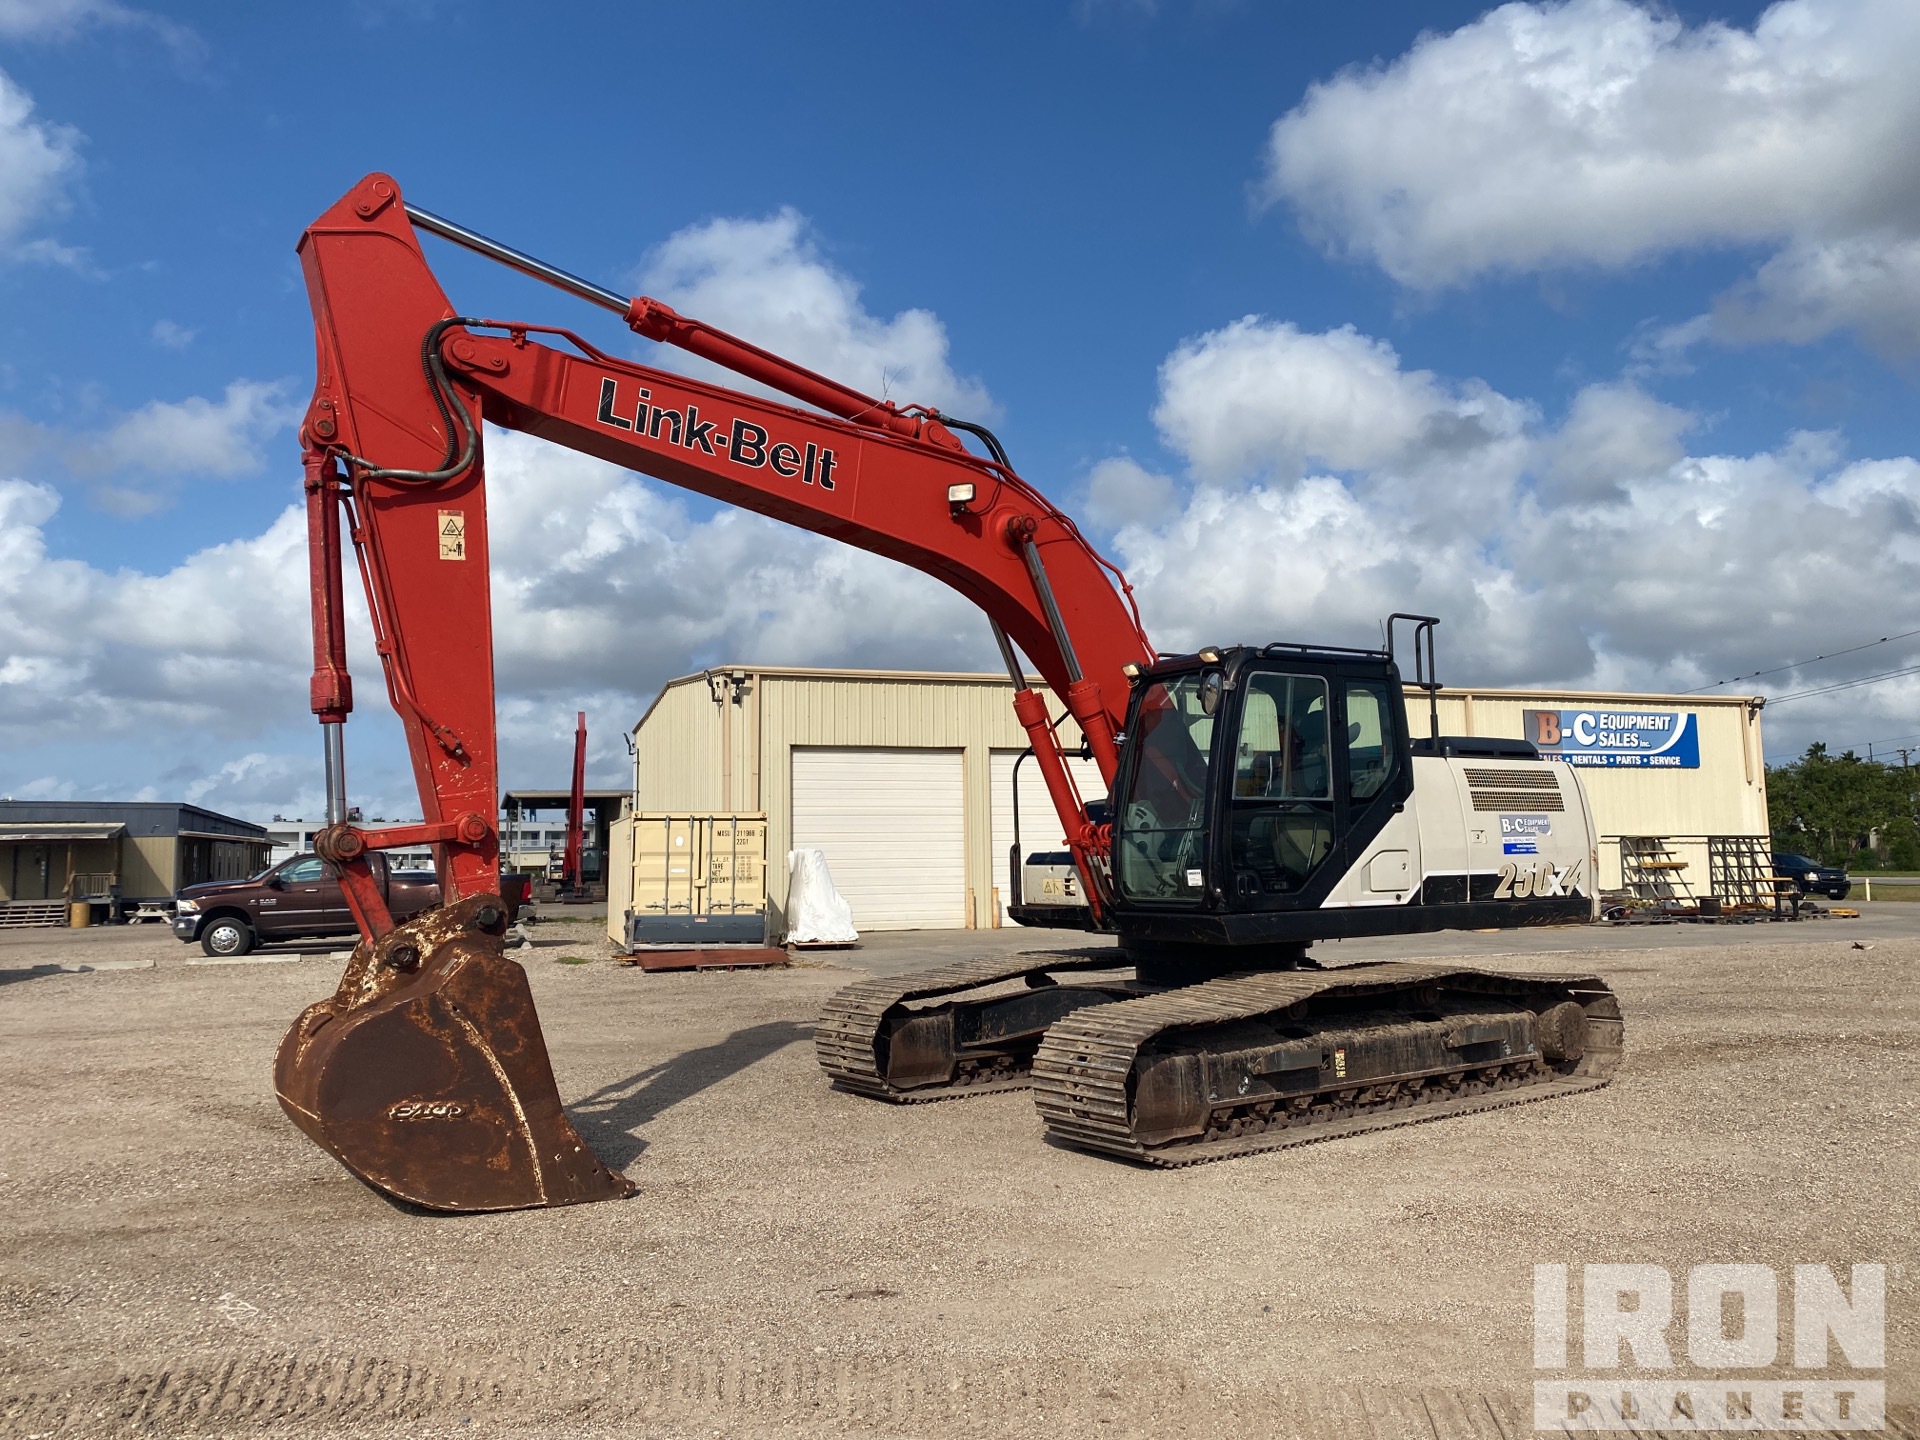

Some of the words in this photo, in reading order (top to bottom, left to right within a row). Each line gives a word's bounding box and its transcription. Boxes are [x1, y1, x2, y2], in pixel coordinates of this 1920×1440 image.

[597, 377, 837, 491] Link-Belt
[1535, 712, 1597, 746] B-C
[1599, 714, 1671, 731] EQUIPMENT
[1599, 732, 1639, 748] SALES
[1572, 755, 1608, 765] RENTALS
[1616, 756, 1642, 765] PARTS
[1650, 756, 1681, 766] SERVICE
[1501, 818, 1525, 833] B-C
